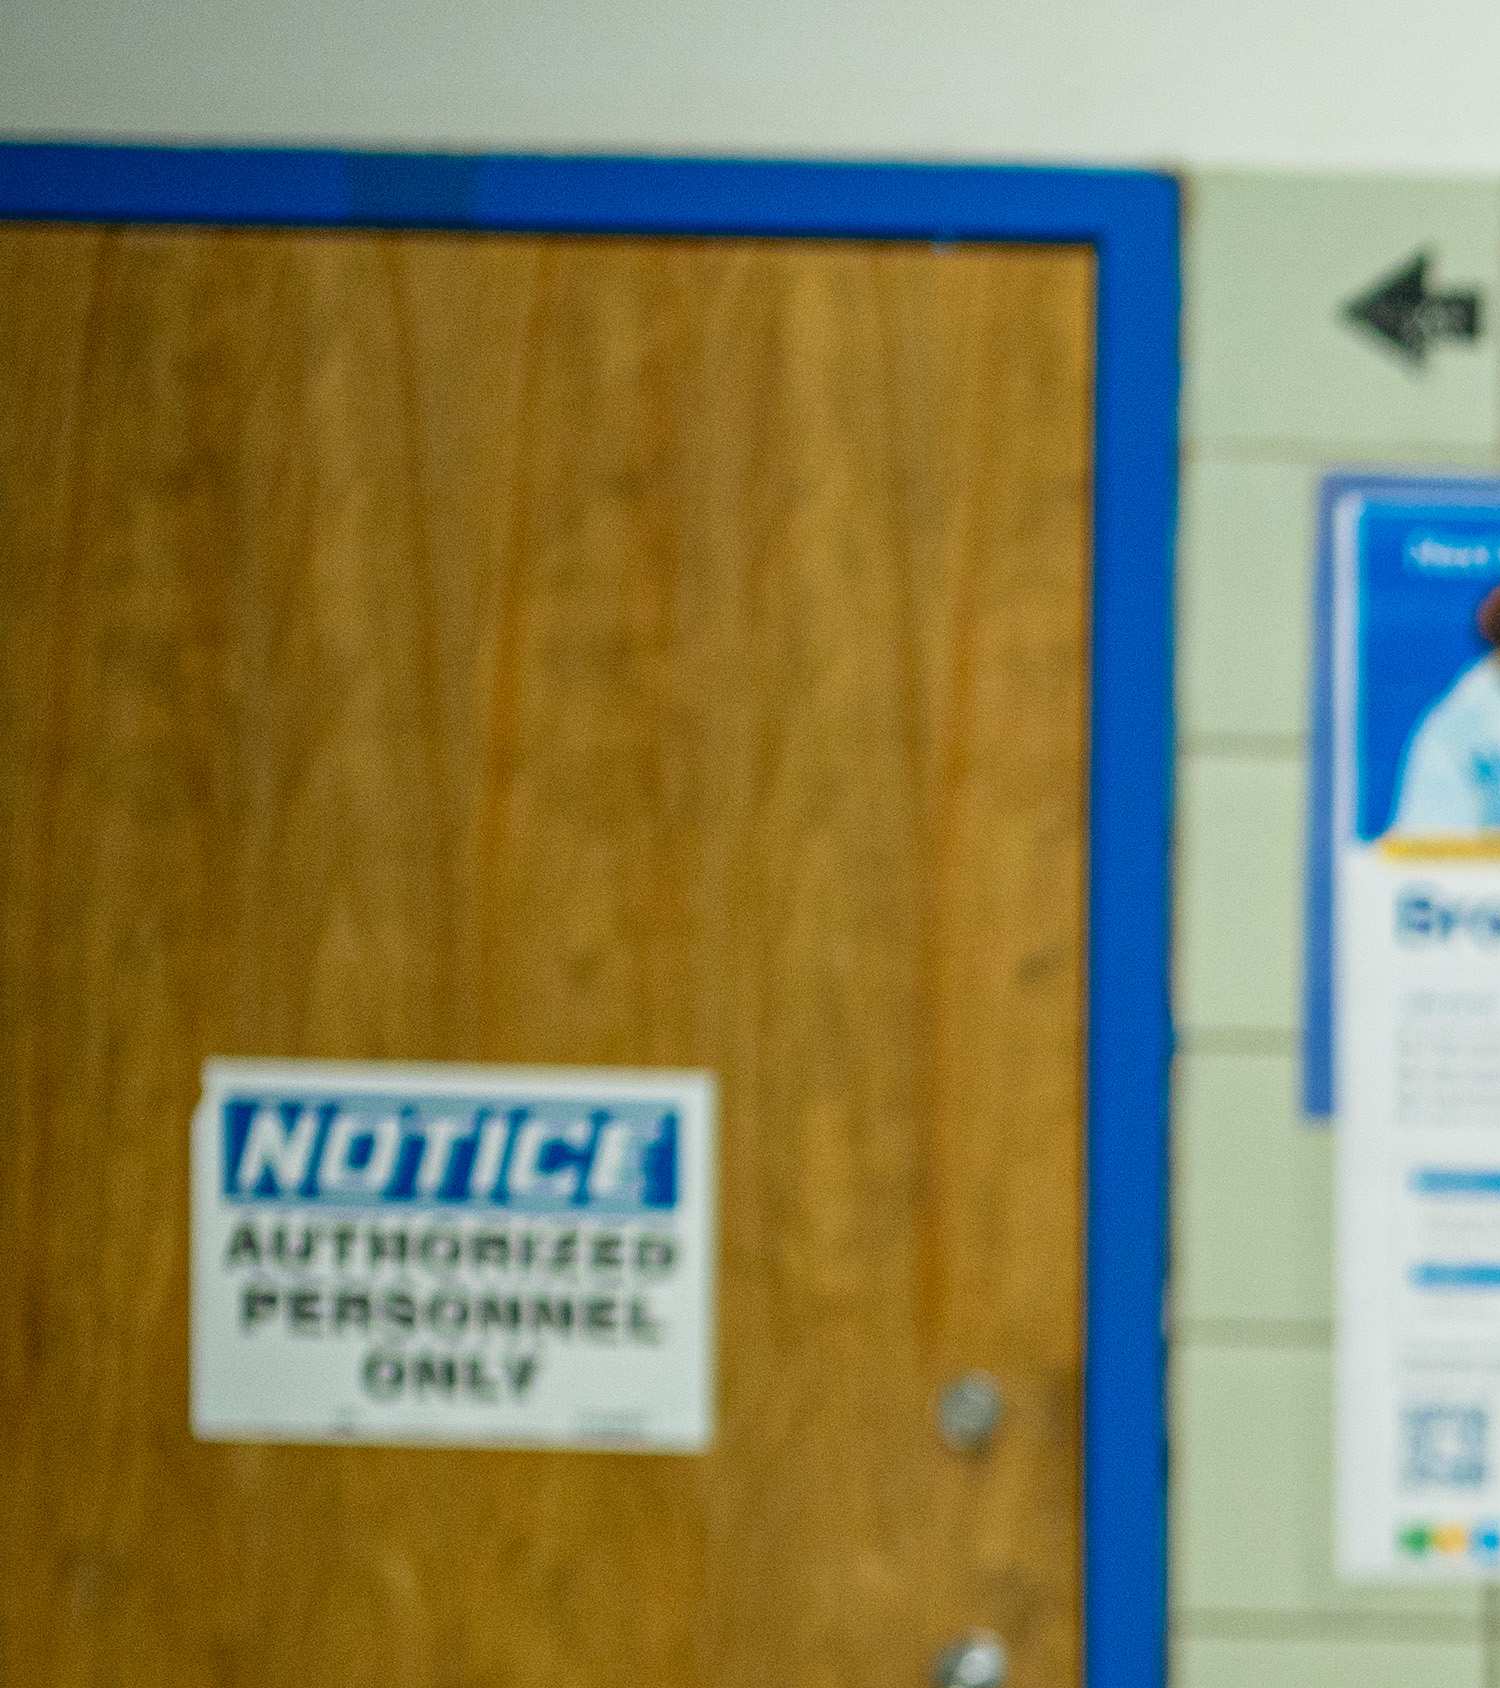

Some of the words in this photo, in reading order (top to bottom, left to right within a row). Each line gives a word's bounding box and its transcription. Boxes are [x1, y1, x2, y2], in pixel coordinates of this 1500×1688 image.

[238, 1110, 664, 1200] NOTICE
[224, 1219, 680, 1280] AUTHORIZED
[239, 1285, 664, 1346] PERSONNEL
[361, 1351, 540, 1399] ONLY
